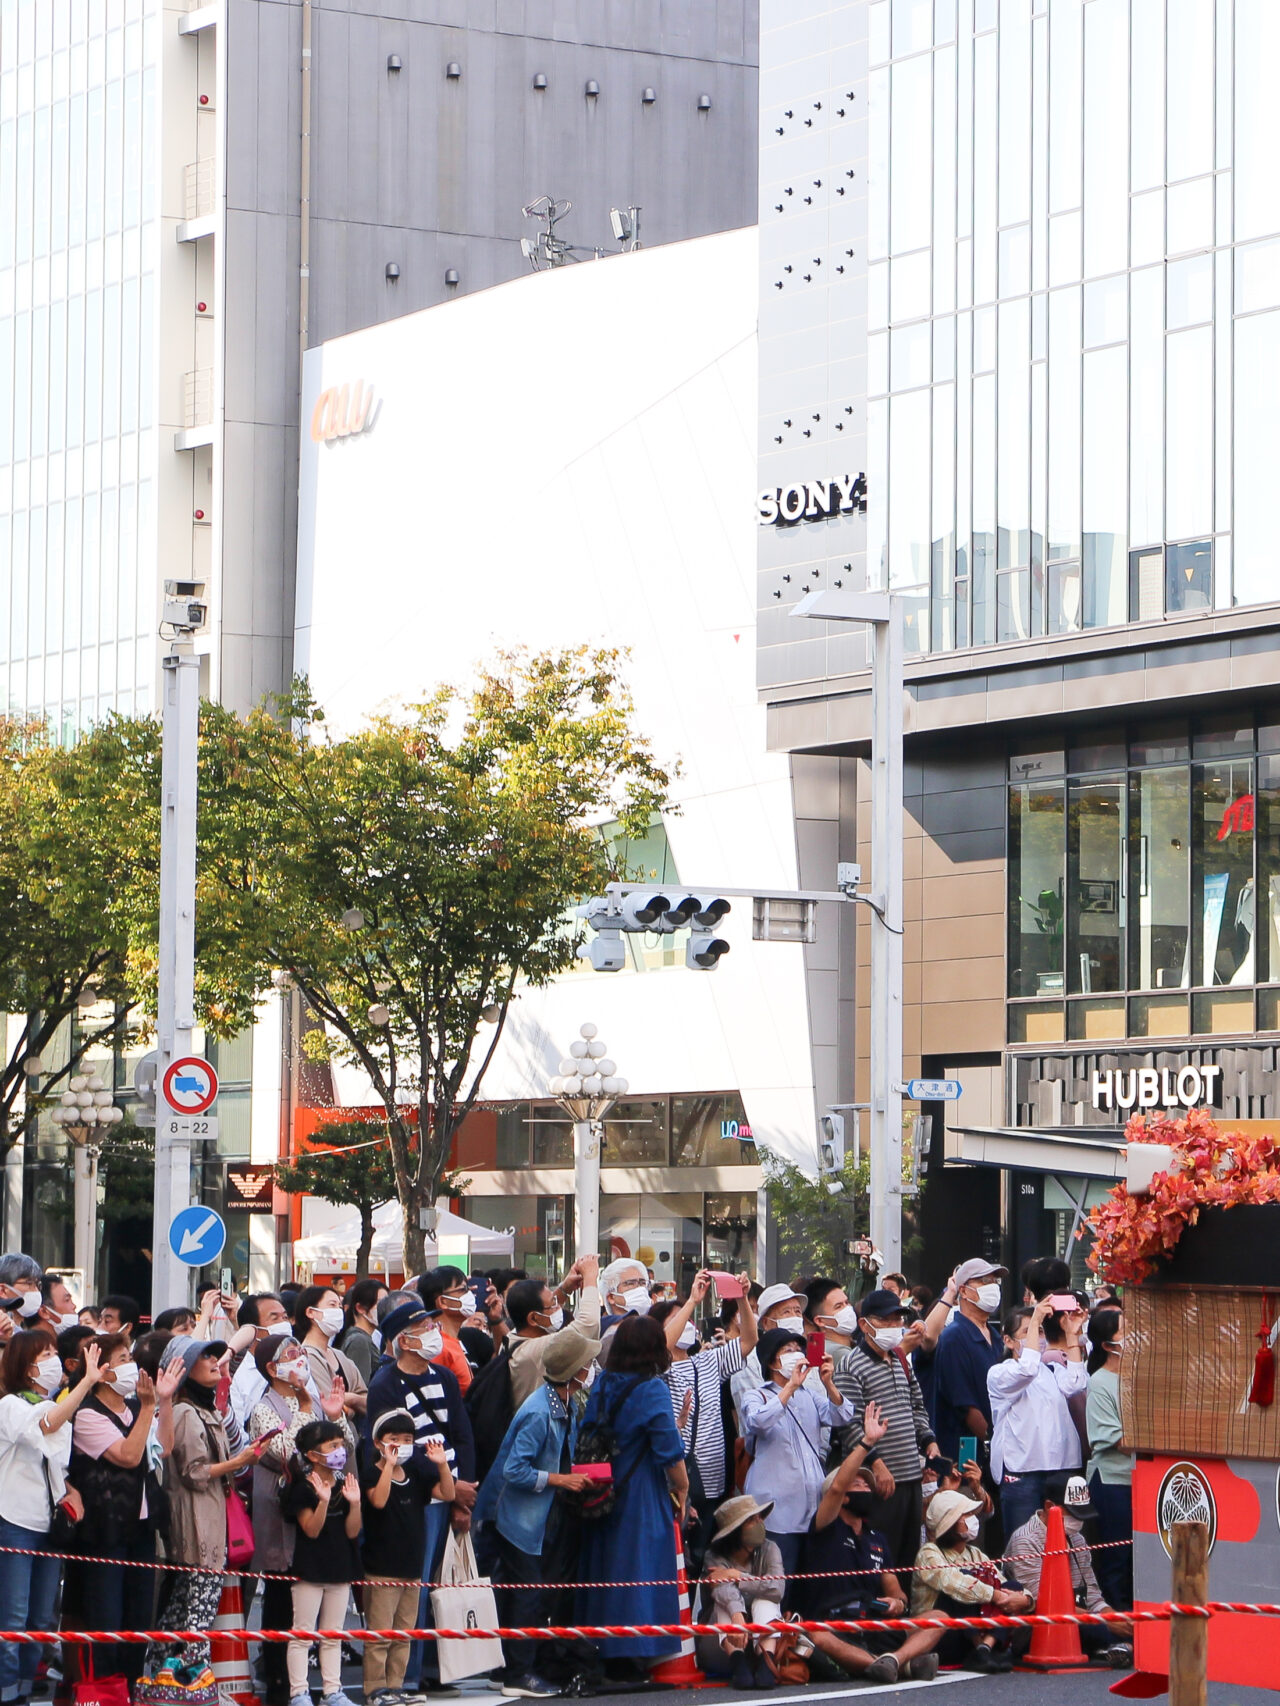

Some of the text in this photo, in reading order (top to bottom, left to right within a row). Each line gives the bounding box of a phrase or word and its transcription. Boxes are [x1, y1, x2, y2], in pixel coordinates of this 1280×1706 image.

[757, 472, 860, 525] SONY
[1092, 1064, 1220, 1109] HUBLOT
[721, 1120, 738, 1139] UQ
[1021, 1184, 1035, 1195] S10a
